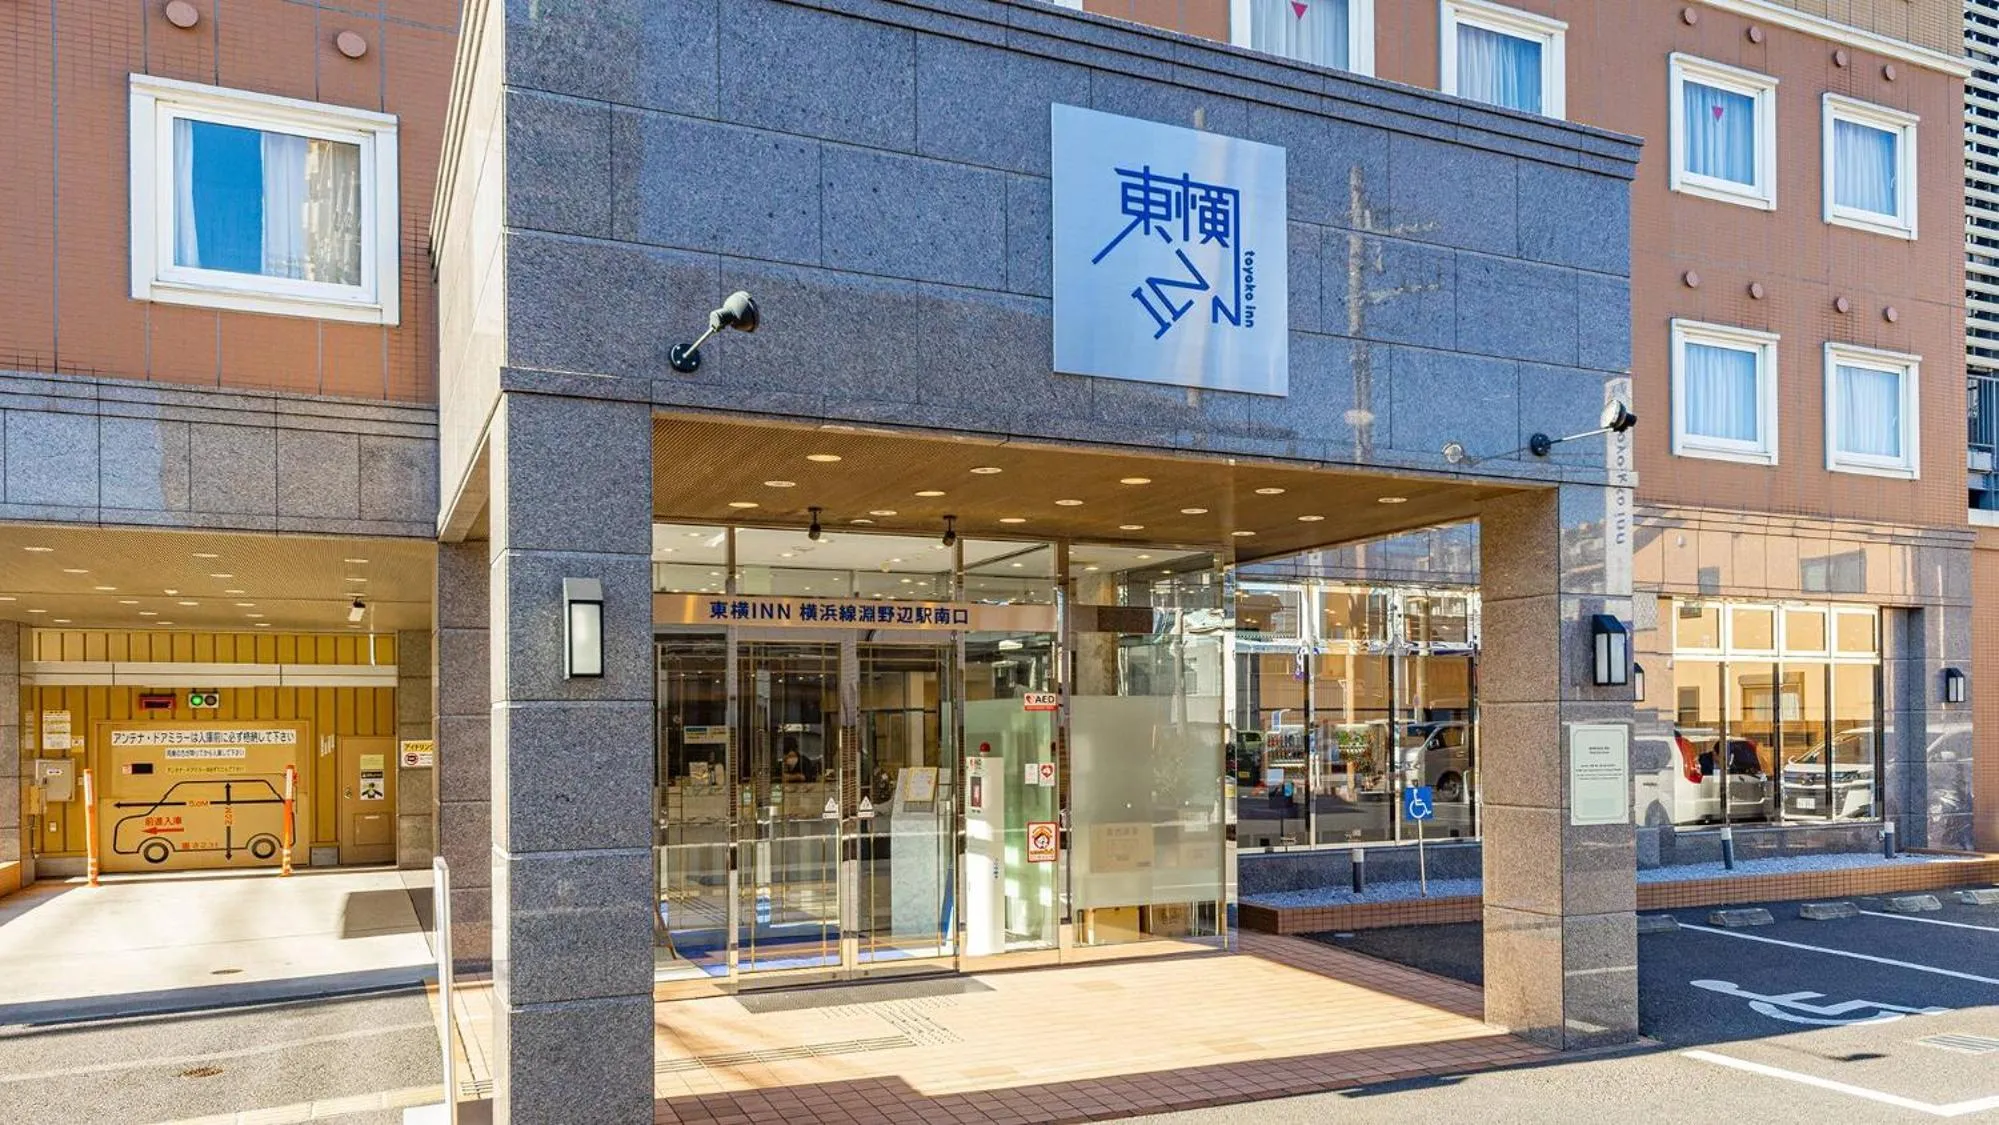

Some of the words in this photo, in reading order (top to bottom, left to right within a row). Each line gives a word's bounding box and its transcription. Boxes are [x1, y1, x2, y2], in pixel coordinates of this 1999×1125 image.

[1242, 250, 1256, 300] toyoko
[1244, 305, 1257, 329] inn
[709, 600, 791, 621] 東横INN
[799, 603, 969, 626] 横浜線淵野辺駅南口
[1035, 695, 1055, 704] AED
